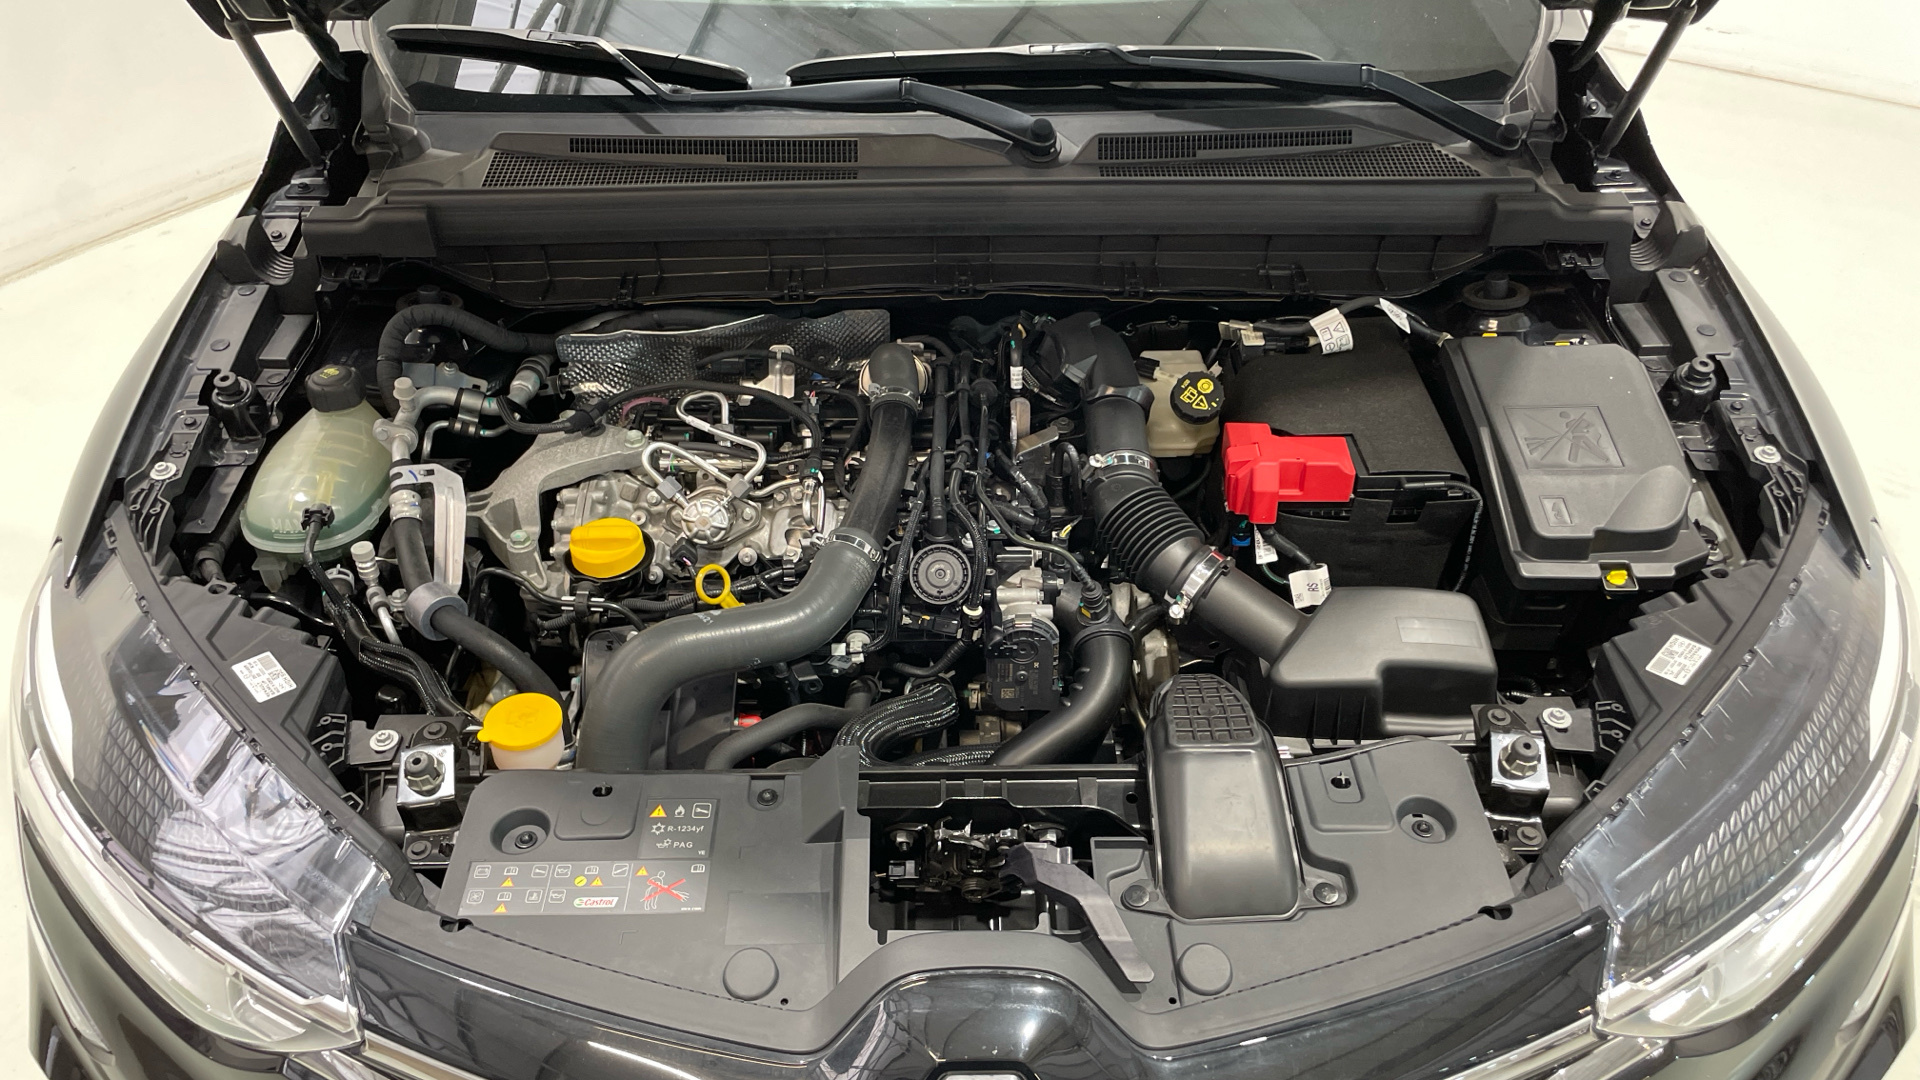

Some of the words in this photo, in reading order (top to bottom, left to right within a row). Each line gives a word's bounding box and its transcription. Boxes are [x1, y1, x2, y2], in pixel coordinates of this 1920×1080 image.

[1306, 582, 1319, 592] RS
[667, 825, 704, 833] R-1234yf
[584, 898, 614, 906] Castrol
